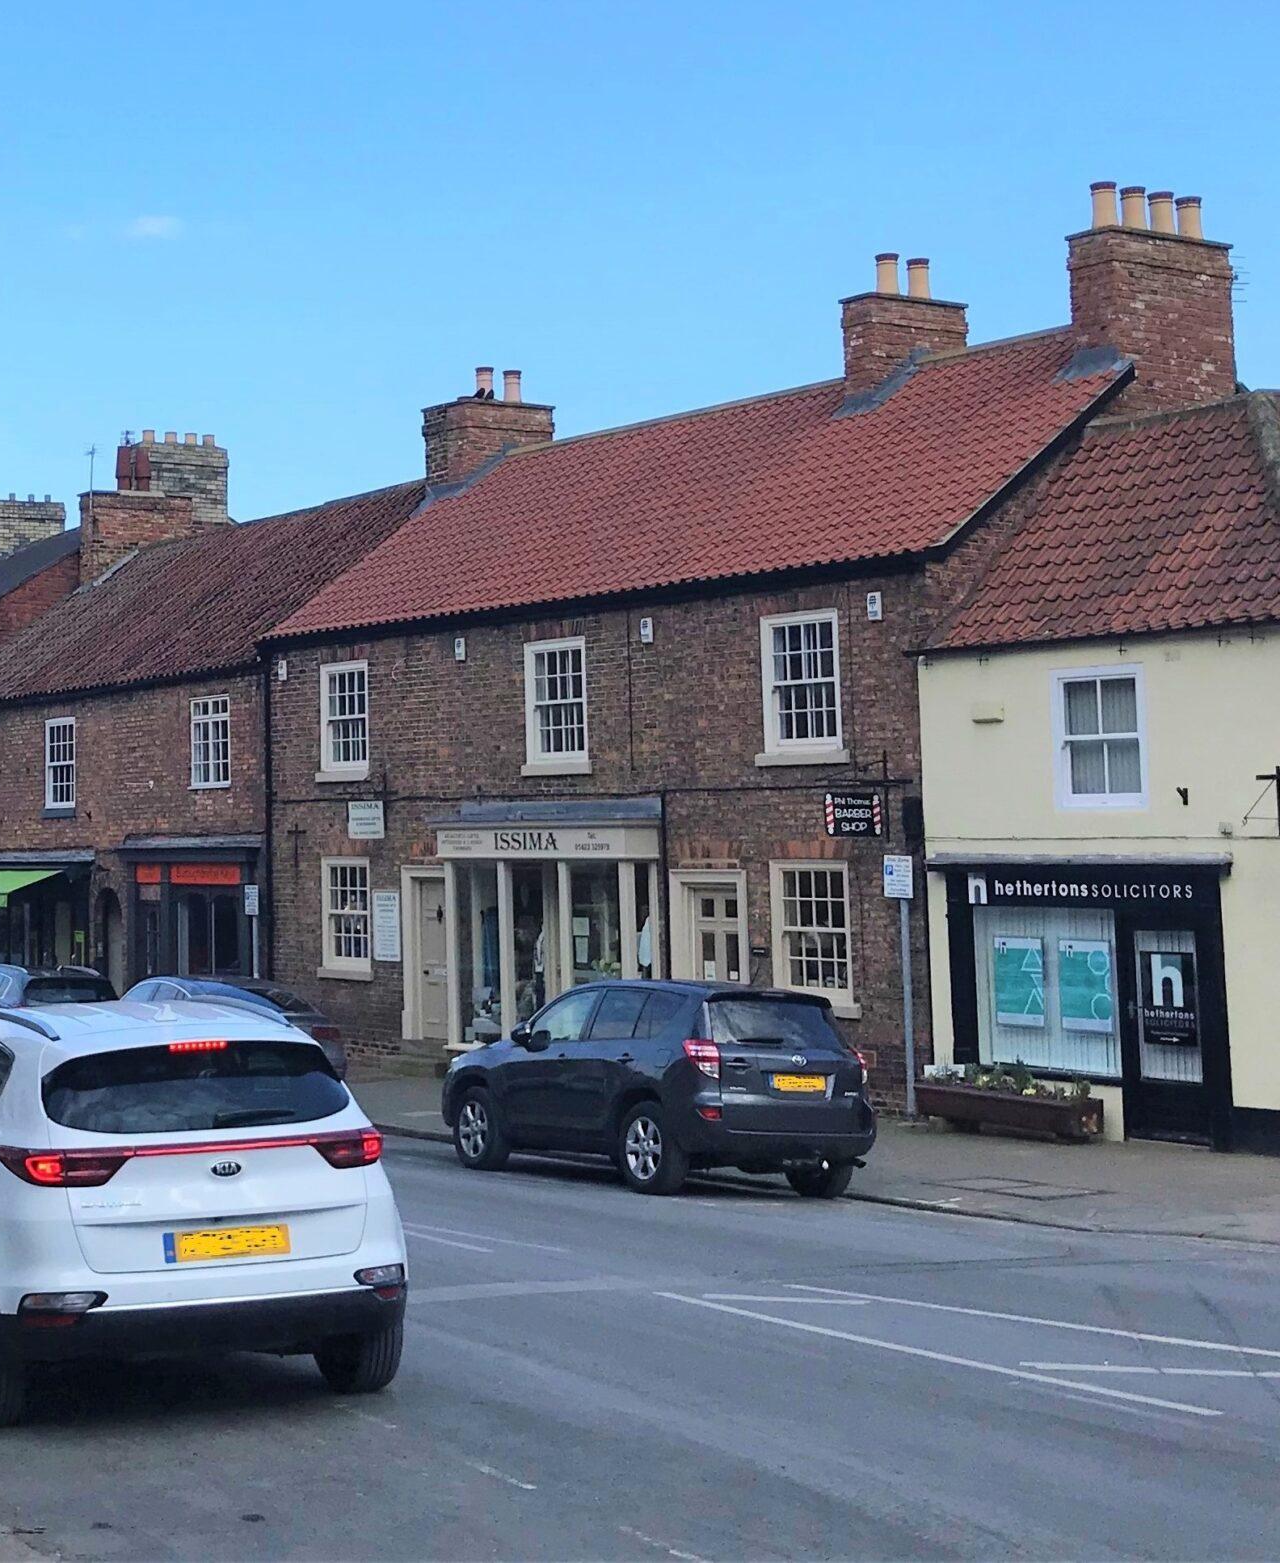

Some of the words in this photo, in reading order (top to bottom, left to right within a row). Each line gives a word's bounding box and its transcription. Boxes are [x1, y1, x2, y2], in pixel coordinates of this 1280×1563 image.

[835, 808, 872, 818] BARBER
[841, 821, 868, 831] SHOP
[494, 832, 559, 850] ISSIMA
[1144, 1008, 1195, 1020] hethertons
[216, 1162, 237, 1175] KIA
